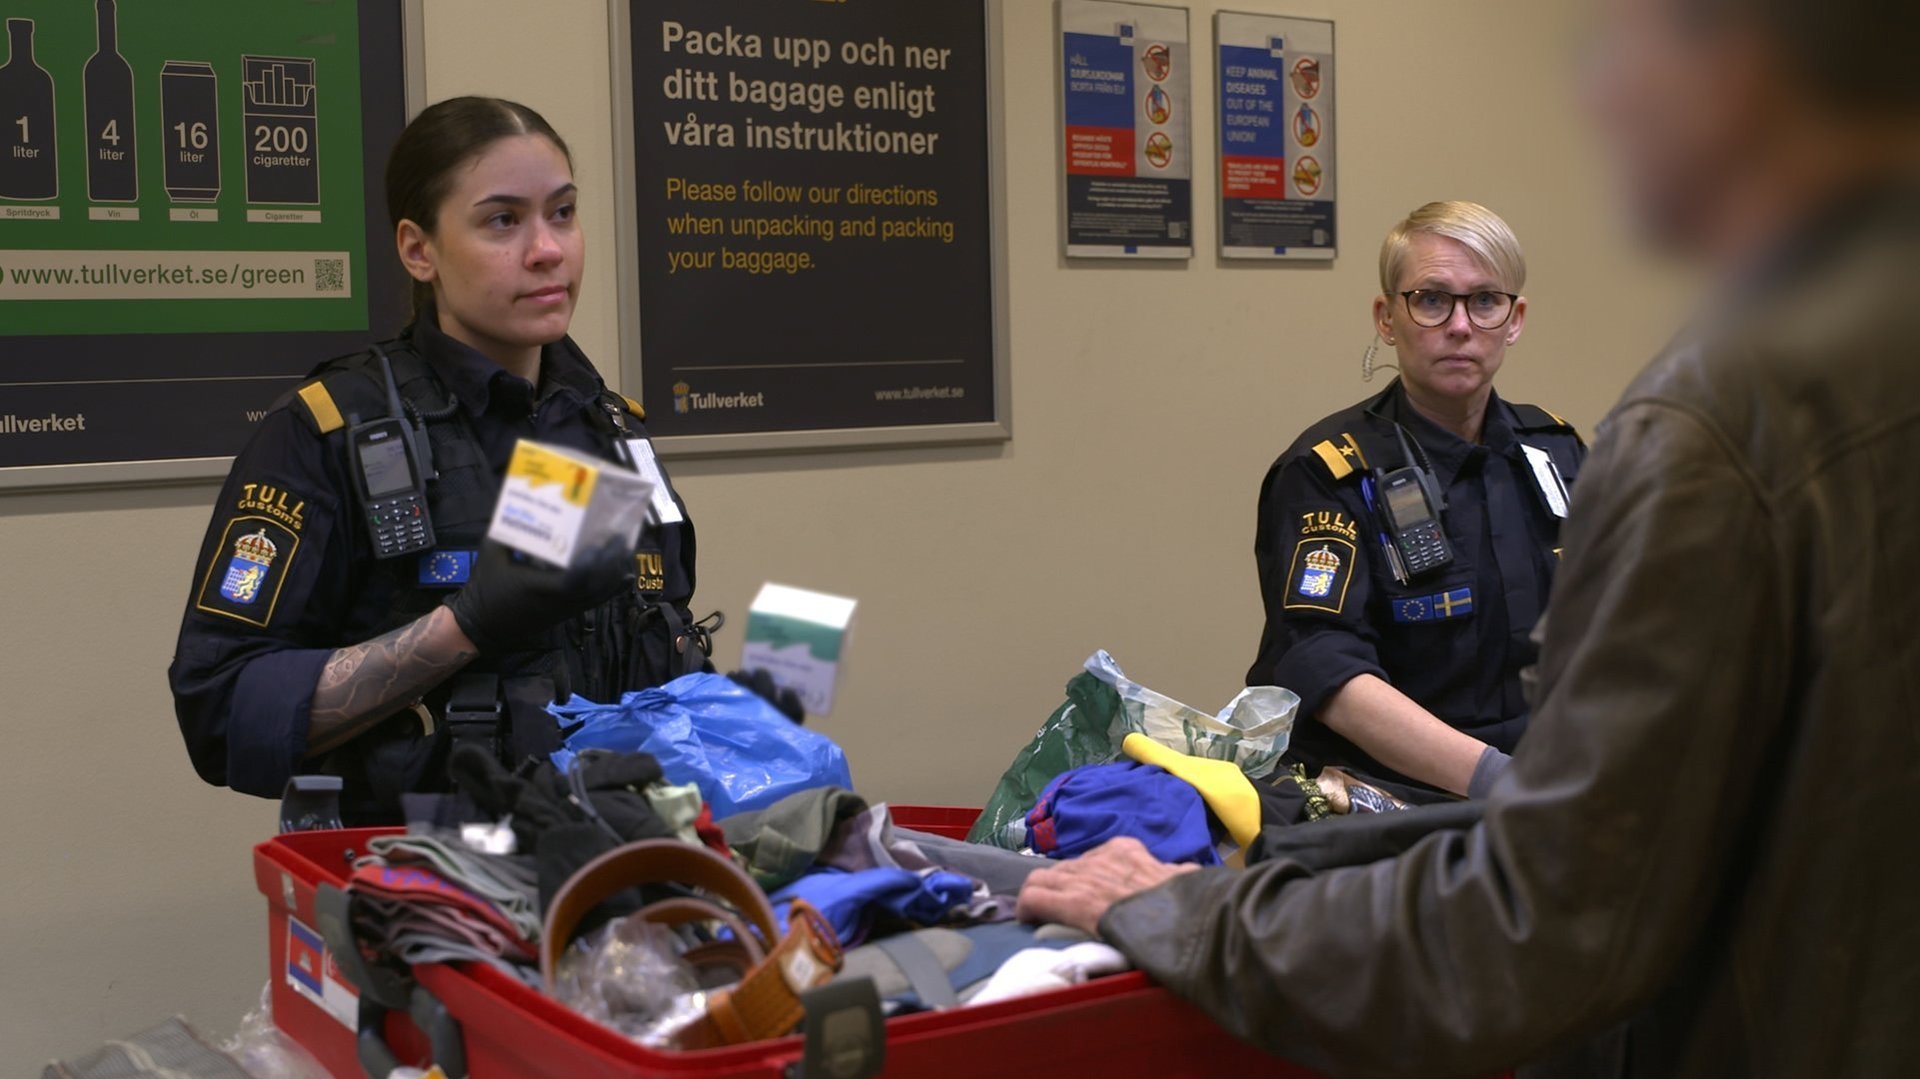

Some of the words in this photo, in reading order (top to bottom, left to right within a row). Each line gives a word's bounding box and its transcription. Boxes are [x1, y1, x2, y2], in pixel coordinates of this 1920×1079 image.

[662, 20, 762, 58] Packa
[773, 36, 831, 69] upp
[841, 36, 895, 67] och
[905, 46, 951, 71] ner
[1226, 66, 1246, 78] KEEP
[1247, 68, 1278, 81] ANIMAL
[663, 68, 719, 101] ditt
[729, 71, 845, 114] bagage
[853, 80, 936, 119] enligt
[1226, 82, 1267, 96] DISEASES
[1226, 98, 1244, 111] OUT
[1245, 99, 1256, 111] OF
[1258, 100, 1274, 112] THE
[15, 115, 29, 144] 1
[1226, 114, 1270, 128] EUROPEAN
[101, 119, 121, 146] 4
[174, 121, 209, 150] 16
[254, 125, 308, 154] 200
[663, 112, 735, 148] våra
[745, 116, 939, 155] instruktioner
[13, 145, 40, 158] liter
[99, 148, 125, 161] liter
[180, 150, 205, 163] liter
[253, 155, 311, 168] cigaretter
[666, 177, 737, 202] Please
[741, 179, 803, 203] follow
[807, 186, 842, 204] our
[846, 183, 939, 207] directions
[6, 208, 51, 218] Spritdryck
[107, 209, 121, 218] Vin
[264, 212, 304, 222] Cigaretter
[666, 212, 724, 235] when
[730, 214, 834, 242] unpacking
[839, 215, 877, 237] and
[881, 216, 954, 244] packing
[667, 251, 716, 275] your
[721, 246, 816, 275] baggage.
[10, 263, 305, 289] www.tullverket.se/green
[689, 391, 764, 410] Tullverket
[874, 386, 965, 401] www.tullverket.se
[0, 412, 87, 434] llverket
[244, 483, 304, 521] TULL
[238, 499, 302, 530] Customs
[1302, 511, 1356, 535] TULL
[1301, 523, 1356, 541] Customs
[638, 576, 664, 589] Cust
